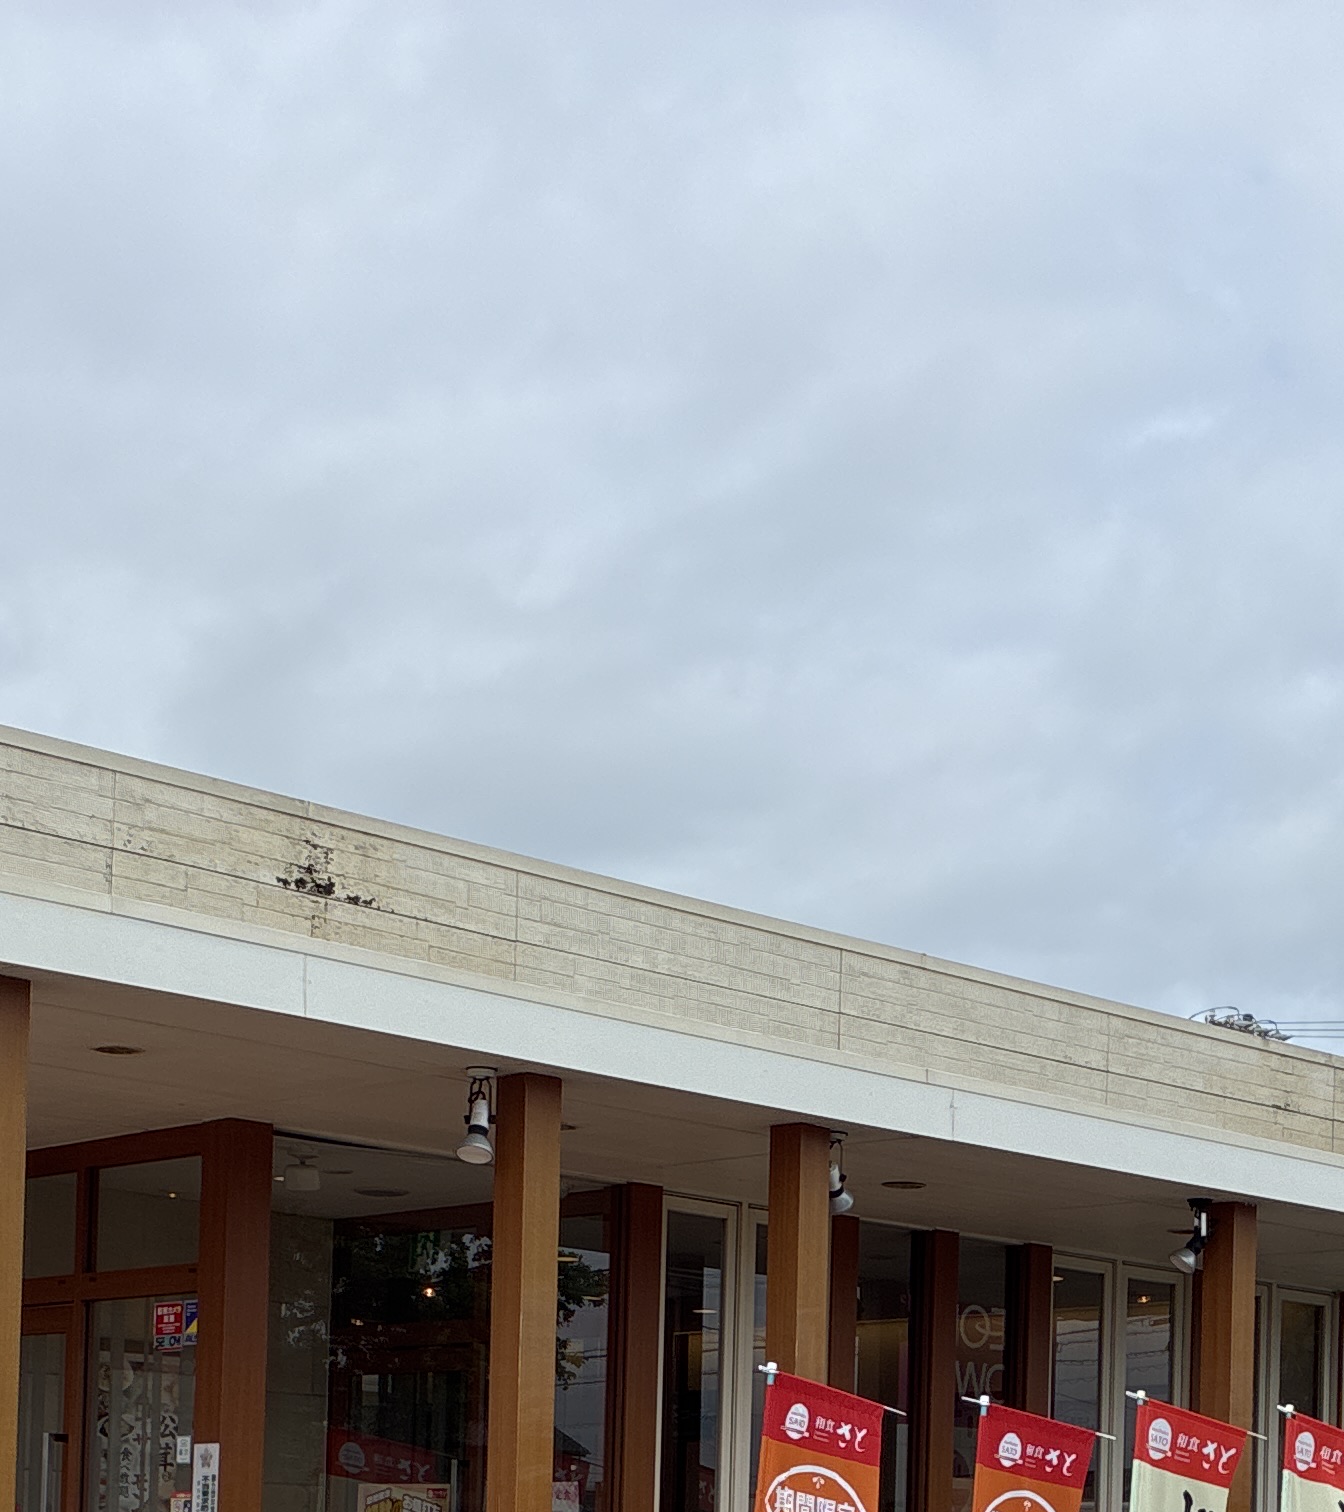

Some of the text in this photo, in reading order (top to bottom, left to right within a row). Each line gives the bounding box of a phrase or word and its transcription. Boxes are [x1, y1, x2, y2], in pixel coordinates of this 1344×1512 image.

[815, 1415, 868, 1452] 和食さと
[1026, 1443, 1077, 1477] 和食さと
[1177, 1433, 1237, 1475] 和食さと
